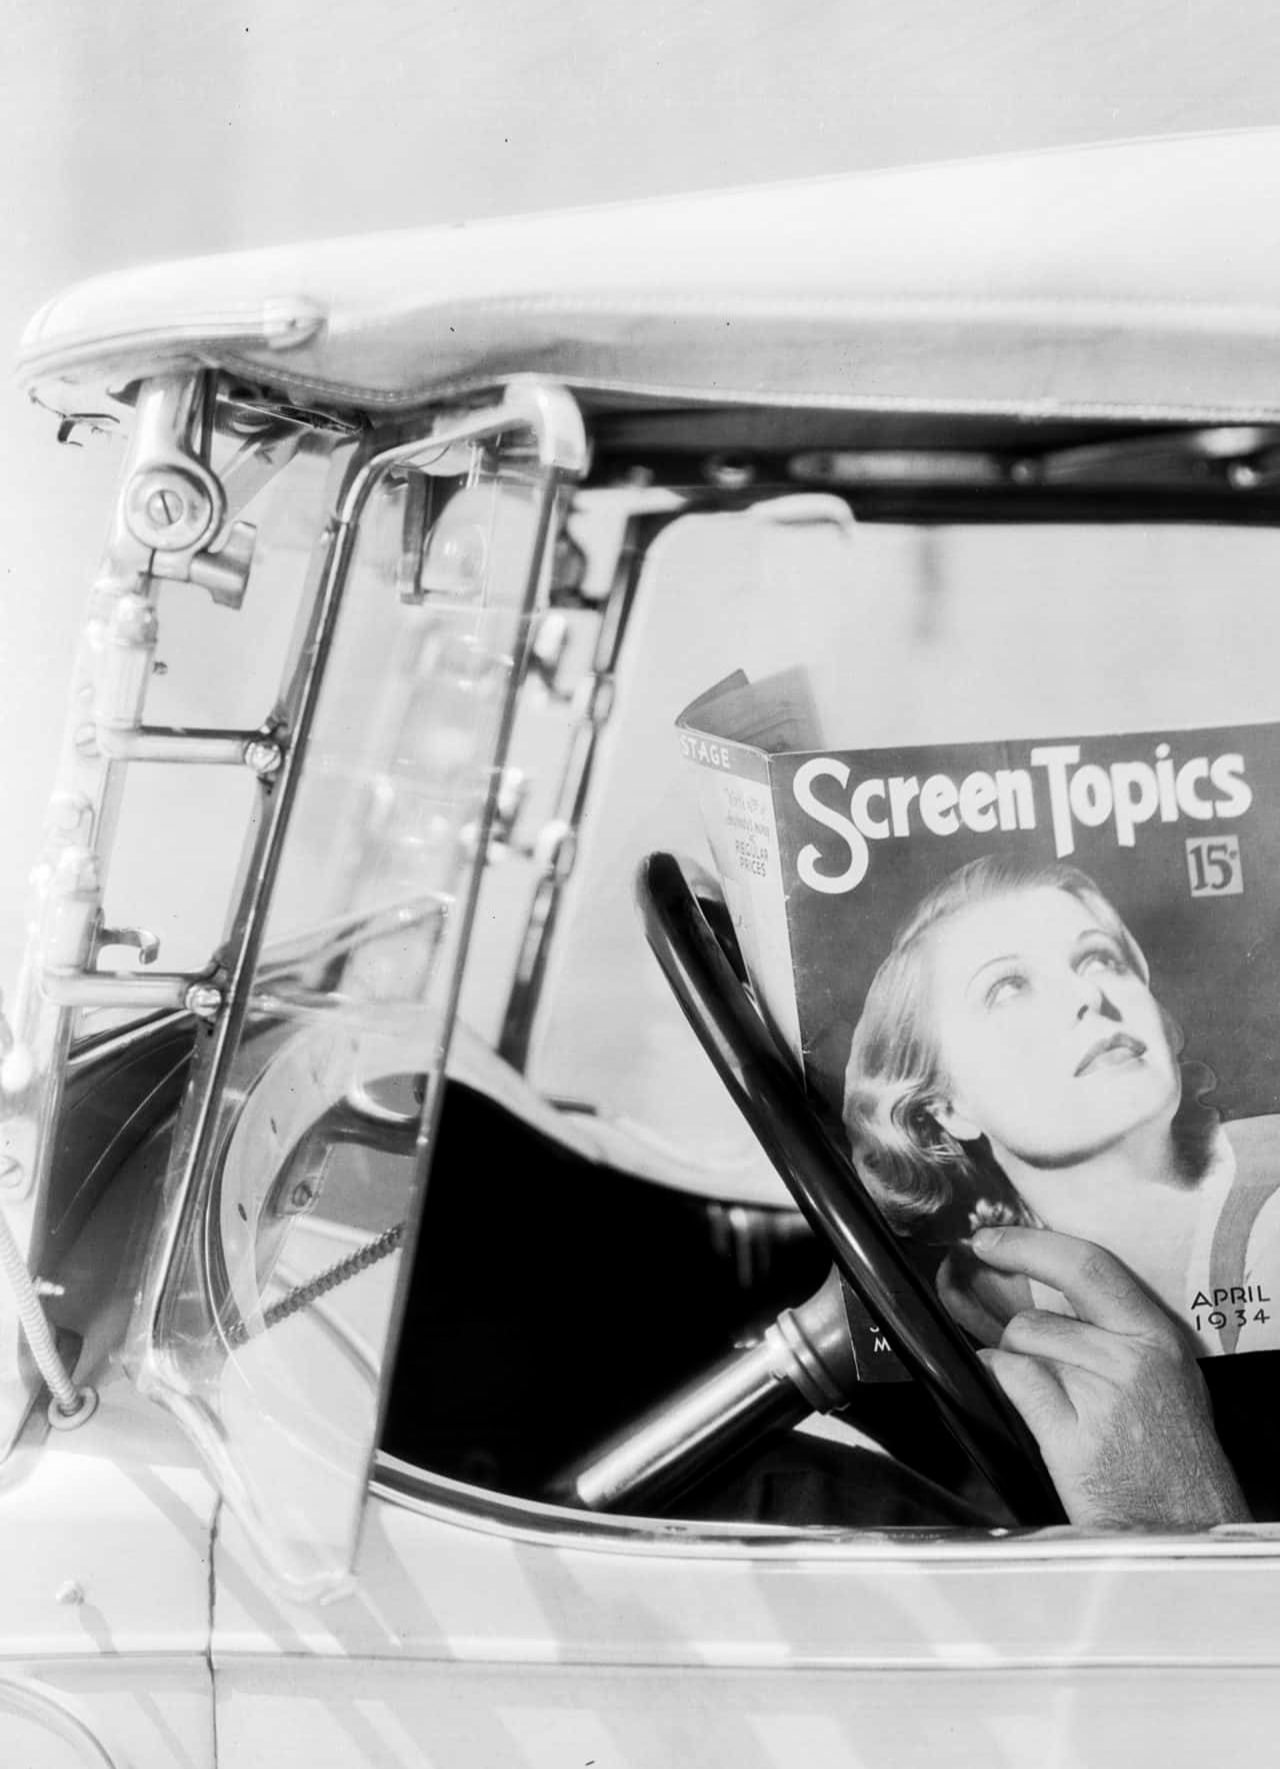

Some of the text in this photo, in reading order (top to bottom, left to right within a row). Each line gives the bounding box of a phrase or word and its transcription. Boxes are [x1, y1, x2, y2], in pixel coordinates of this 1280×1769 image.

[679, 734, 731, 769] STAGE
[793, 743, 1253, 894] Screen Topics
[1191, 1285, 1271, 1310] APRIL
[1196, 1308, 1271, 1331] 1934
